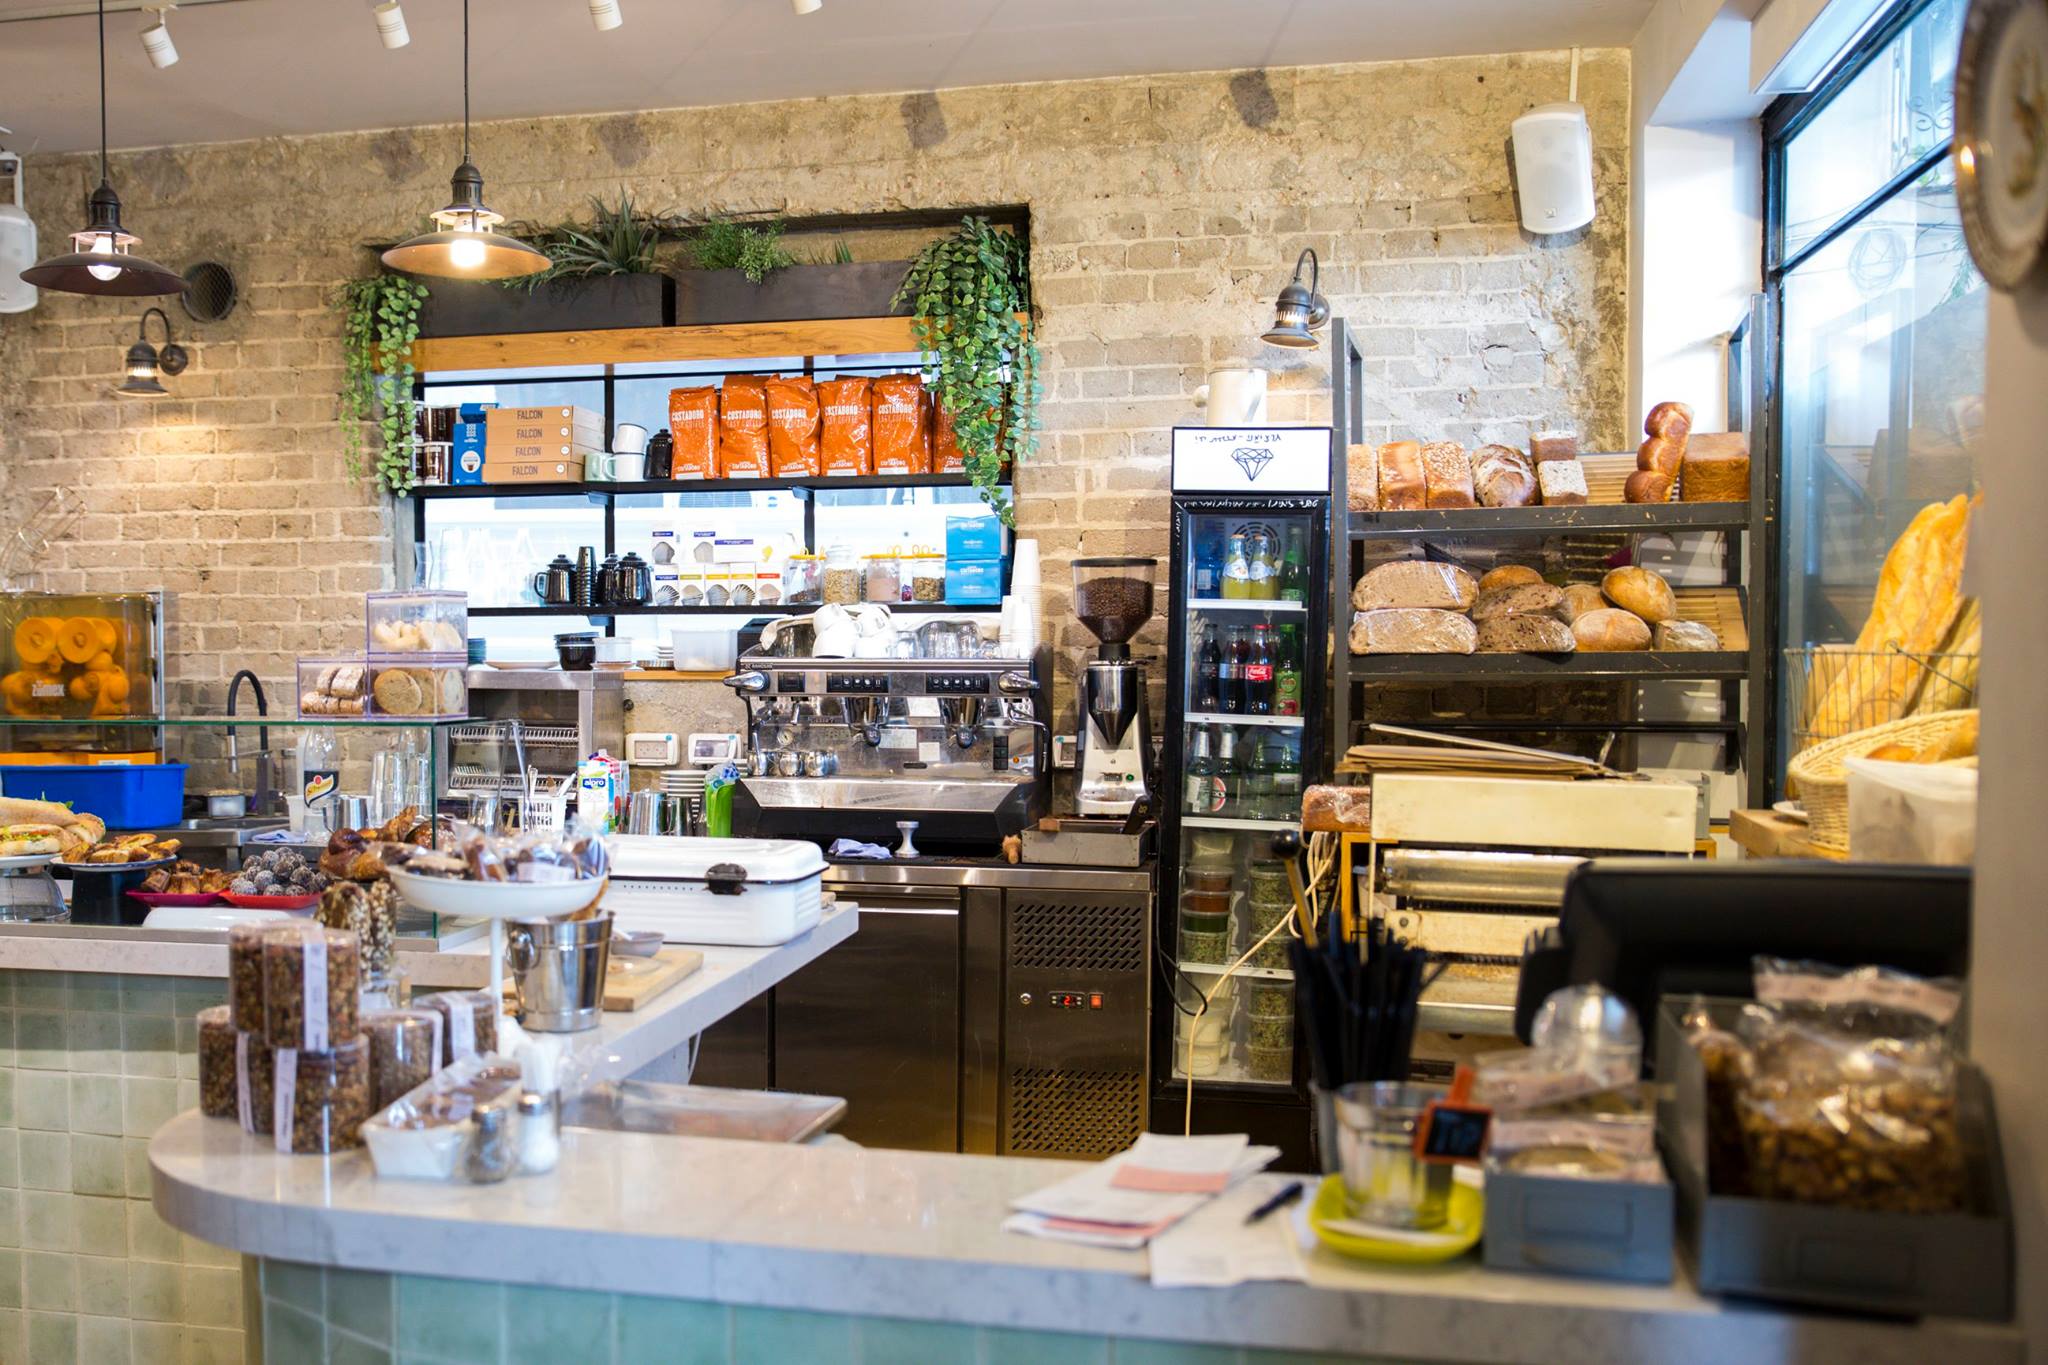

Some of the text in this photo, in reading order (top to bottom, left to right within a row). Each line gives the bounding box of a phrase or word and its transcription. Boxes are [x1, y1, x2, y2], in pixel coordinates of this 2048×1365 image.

[517, 410, 543, 420] FALCON
[516, 428, 542, 438] FALCON
[515, 445, 541, 456] FALCON
[512, 464, 538, 476] FALCON
[583, 778, 605, 789] alpro
